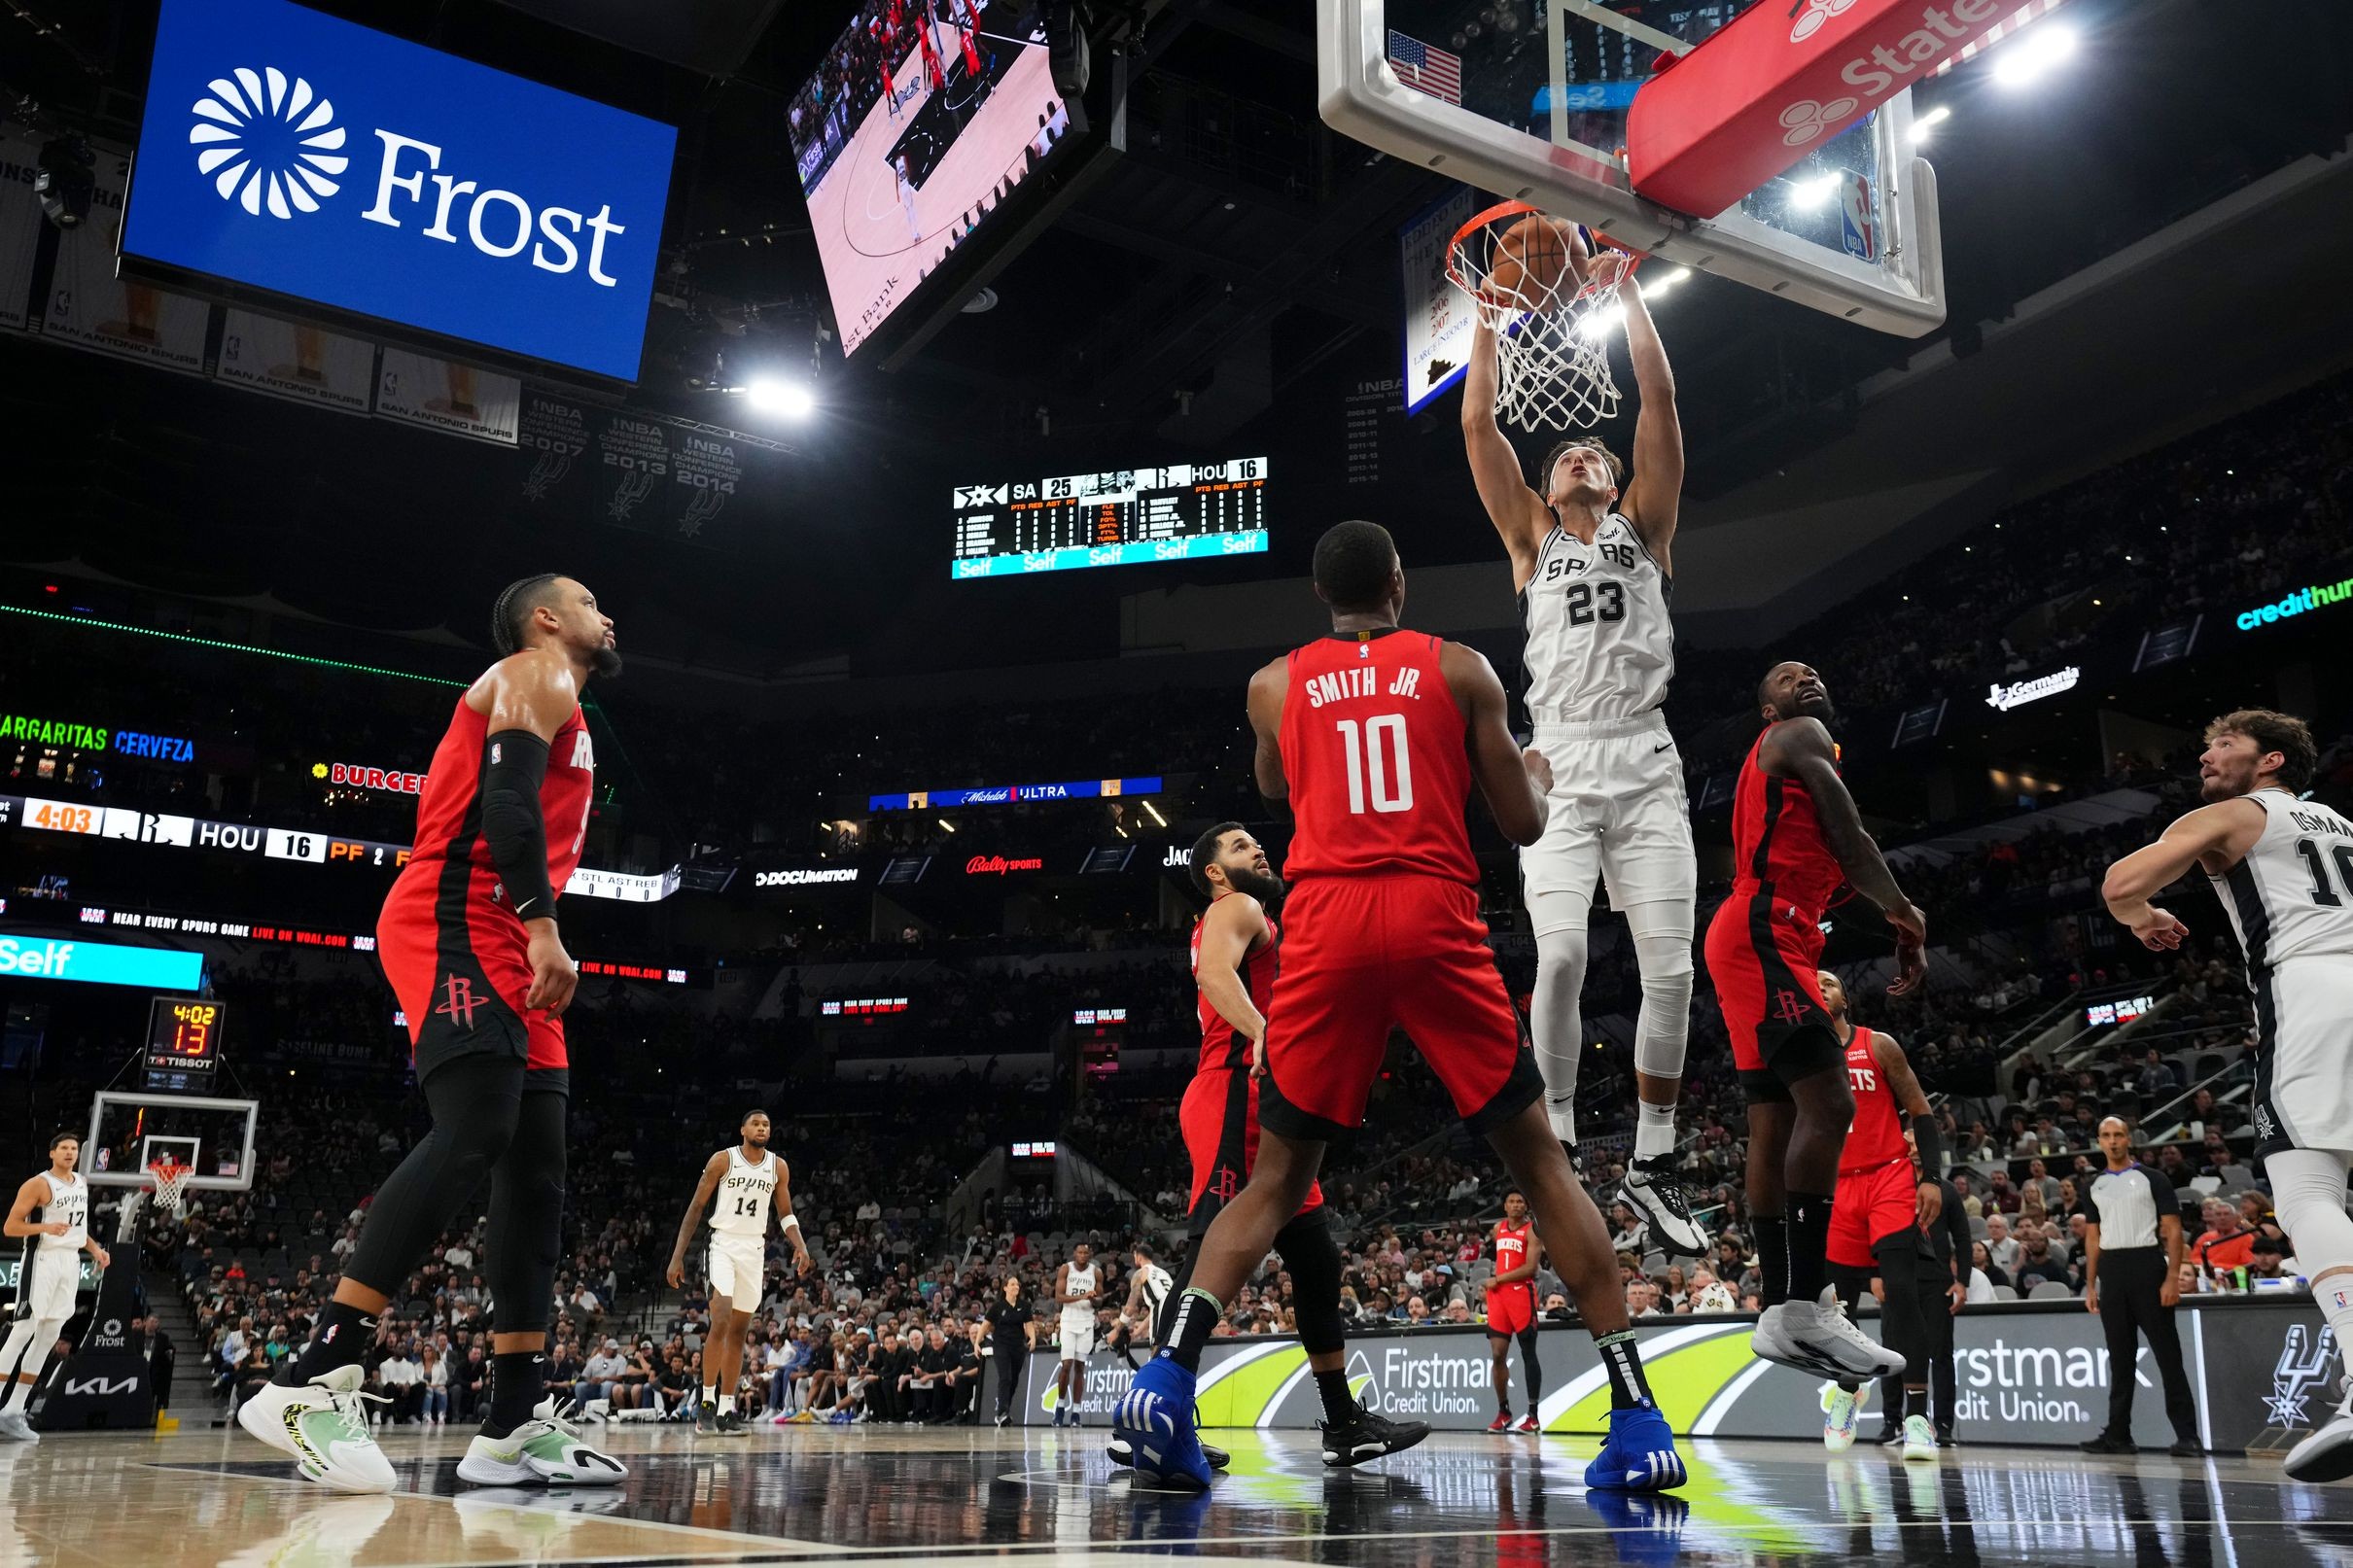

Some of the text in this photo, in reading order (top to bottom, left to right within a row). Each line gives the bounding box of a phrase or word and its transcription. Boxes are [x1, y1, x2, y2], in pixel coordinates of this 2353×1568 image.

[1842, 0, 1998, 96] State
[362, 127, 625, 287] Frost
[1847, 234, 1862, 252] NBA
[861, 277, 900, 328] Bank
[49, 321, 198, 366] SAN ANTONIO SPURS
[224, 366, 363, 407] SAN ANTONIO SPURS
[1365, 378, 1403, 393] NBA
[1346, 394, 1385, 402] DIVISION
[381, 401, 512, 439] SAN ANTONIO SPURS
[528, 410, 581, 428] WESTERN
[540, 401, 582, 421] NBA
[519, 417, 590, 438] CONFERENCE
[519, 423, 587, 445] CHAMPIONS
[607, 429, 662, 445] WESTERN
[619, 418, 663, 438] NBA
[519, 434, 583, 457] 2007
[598, 434, 669, 455] CONFERENCE
[600, 442, 668, 462] CHAMPIONS
[694, 438, 735, 459] NBA
[603, 453, 667, 476] 2013
[673, 453, 742, 475] CONFERENCE
[682, 448, 734, 466] WESTERN
[675, 461, 739, 482] CHAMPIONS
[1013, 460, 1257, 500] SA 25 HOU 16
[677, 470, 735, 495] 2014
[959, 535, 1258, 577] Self Self Self Self Self
[1565, 581, 1627, 628] 23
[1305, 666, 1421, 708] SMITH JR.
[2012, 665, 2080, 697] Germania
[0, 714, 108, 751] ARGARITAS
[1336, 713, 1413, 815] 10
[962, 786, 1067, 805] Michelob ULTRA
[35, 804, 384, 867] 4:03 HOU 16 PF 2
[966, 855, 1042, 876] Bally SPORTS
[581, 873, 658, 889] STL AST REB
[767, 869, 859, 886] DOCUMATION
[588, 883, 650, 902] 0 0 0
[113, 911, 347, 947] HEAR EVERY SPURS GAME LIVE ON WOAI.COM
[0, 938, 75, 976] Self
[581, 961, 600, 974] LIVE
[603, 964, 617, 976] ON
[618, 965, 663, 980] WOAI.COM
[173, 1004, 216, 1025] 4:02
[174, 1024, 207, 1055] 13
[338, 1043, 373, 1059] BUMS
[167, 1056, 213, 1069] TISSOT
[728, 1177, 773, 1194] SPURS
[734, 1197, 758, 1217] 14
[68, 1211, 85, 1227] 17
[1505, 1253, 1510, 1270] 1
[95, 1334, 125, 1347] Frost
[1384, 1348, 1515, 1389] Firstmark
[1081, 1394, 1103, 1413] redit
[1384, 1391, 1430, 1414] Credit
